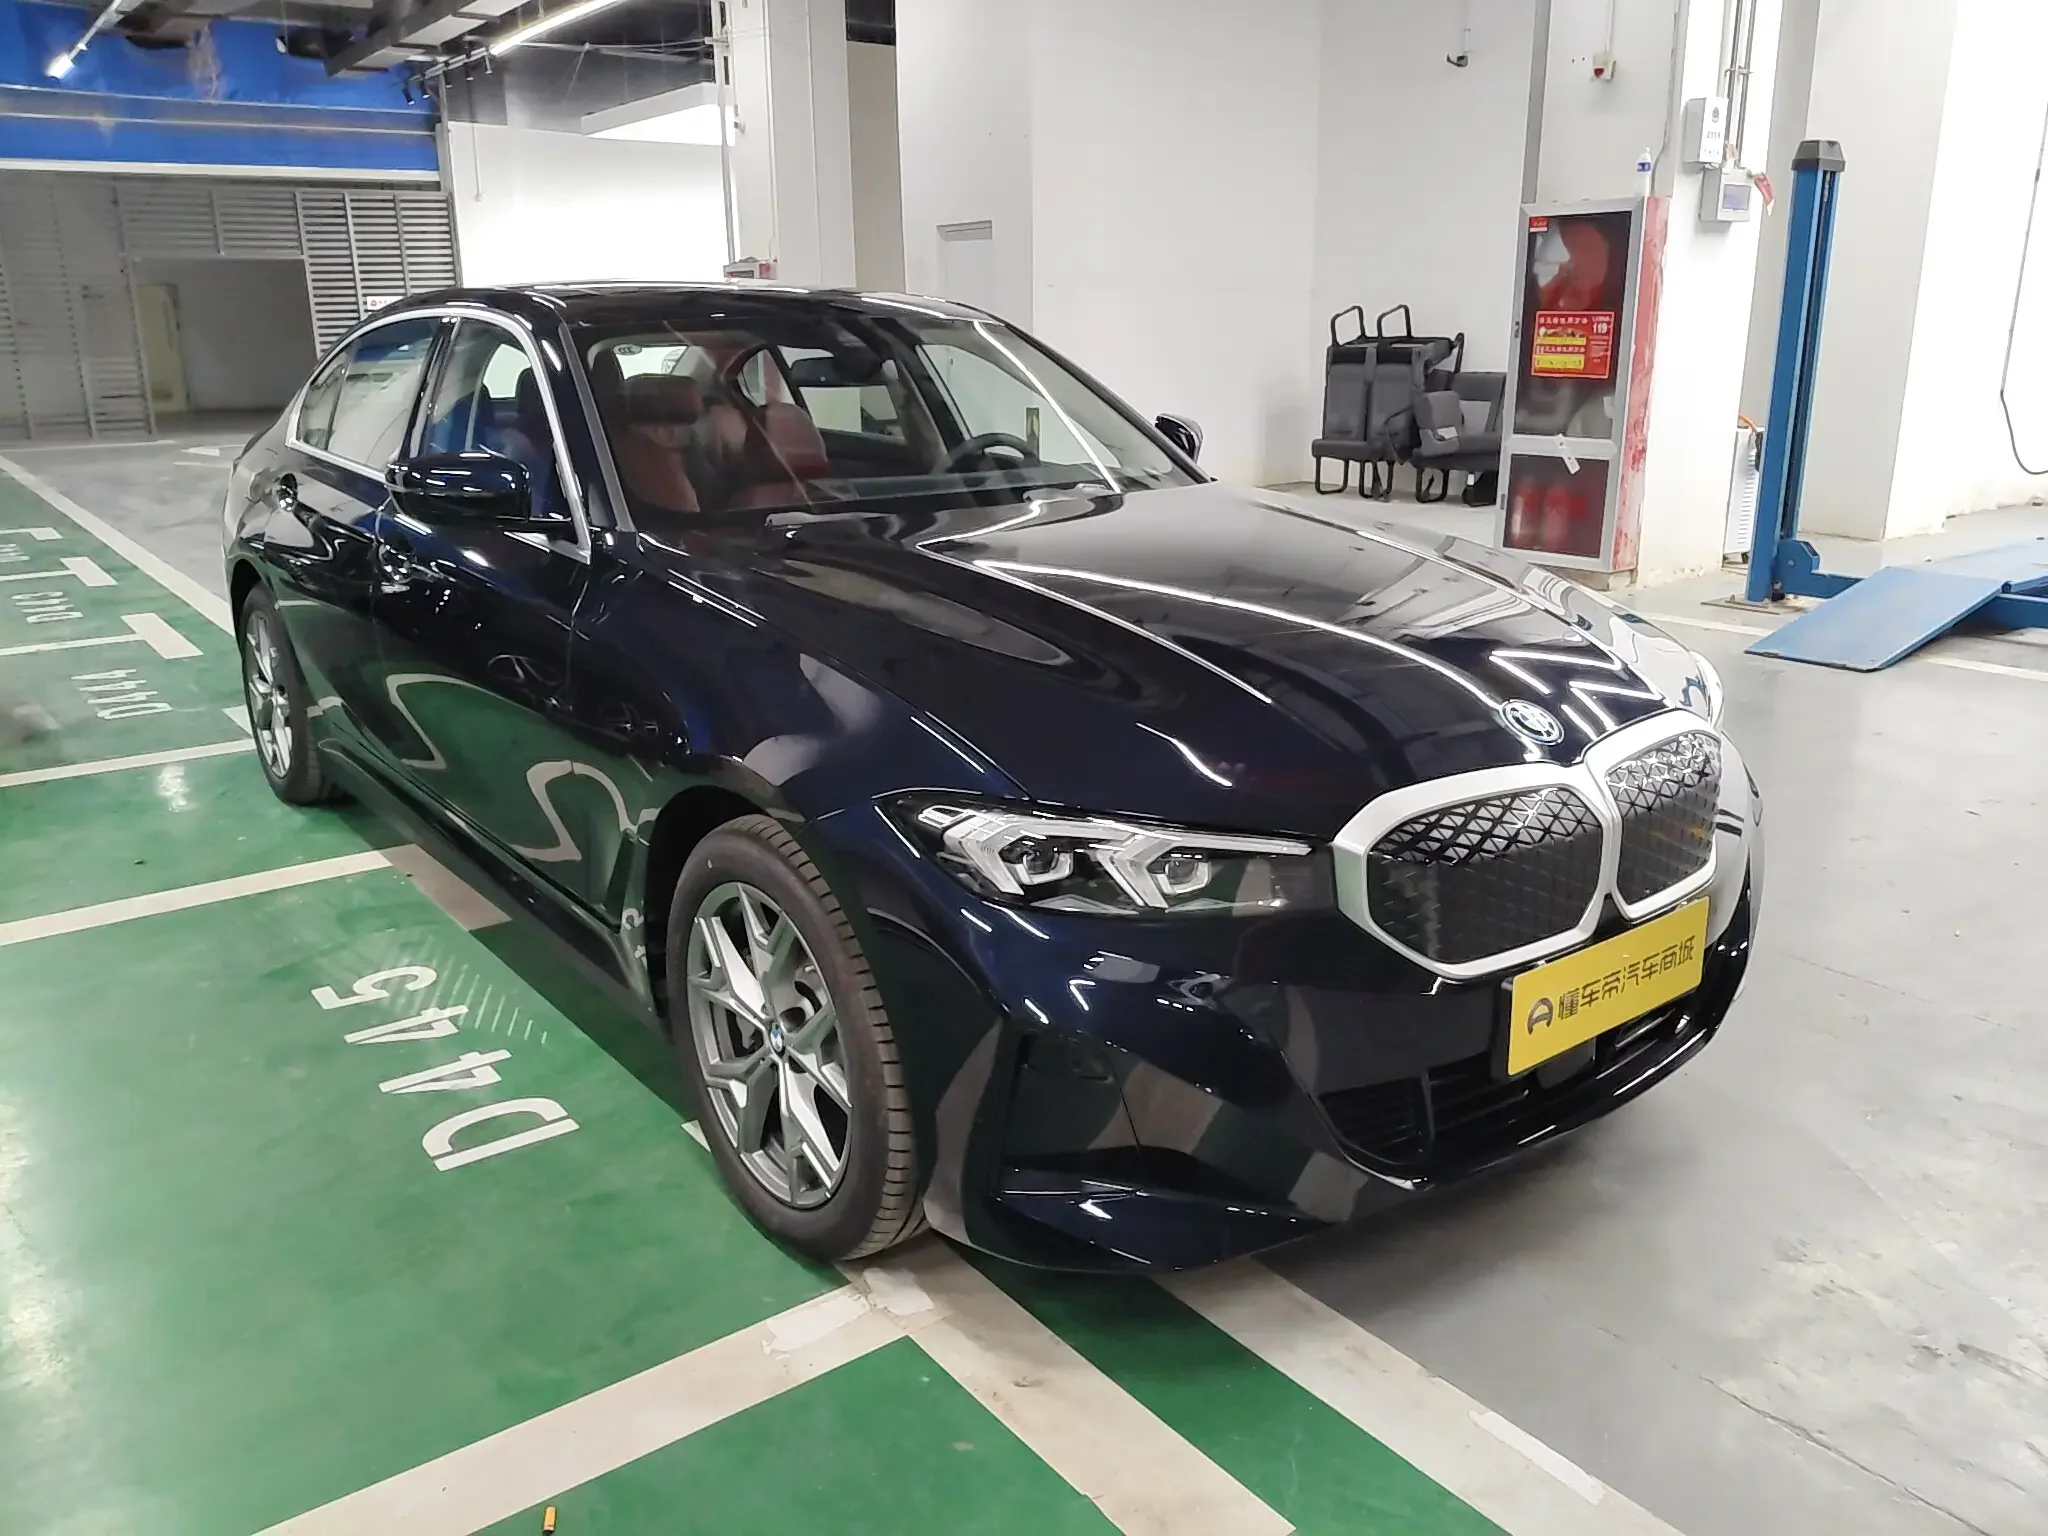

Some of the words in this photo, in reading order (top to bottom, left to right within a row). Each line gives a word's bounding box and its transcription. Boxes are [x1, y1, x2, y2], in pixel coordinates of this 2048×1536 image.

[71, 668, 173, 720] D444
[1558, 935, 1696, 1020] 懂车帝汽车商城
[310, 965, 581, 1172] D445
